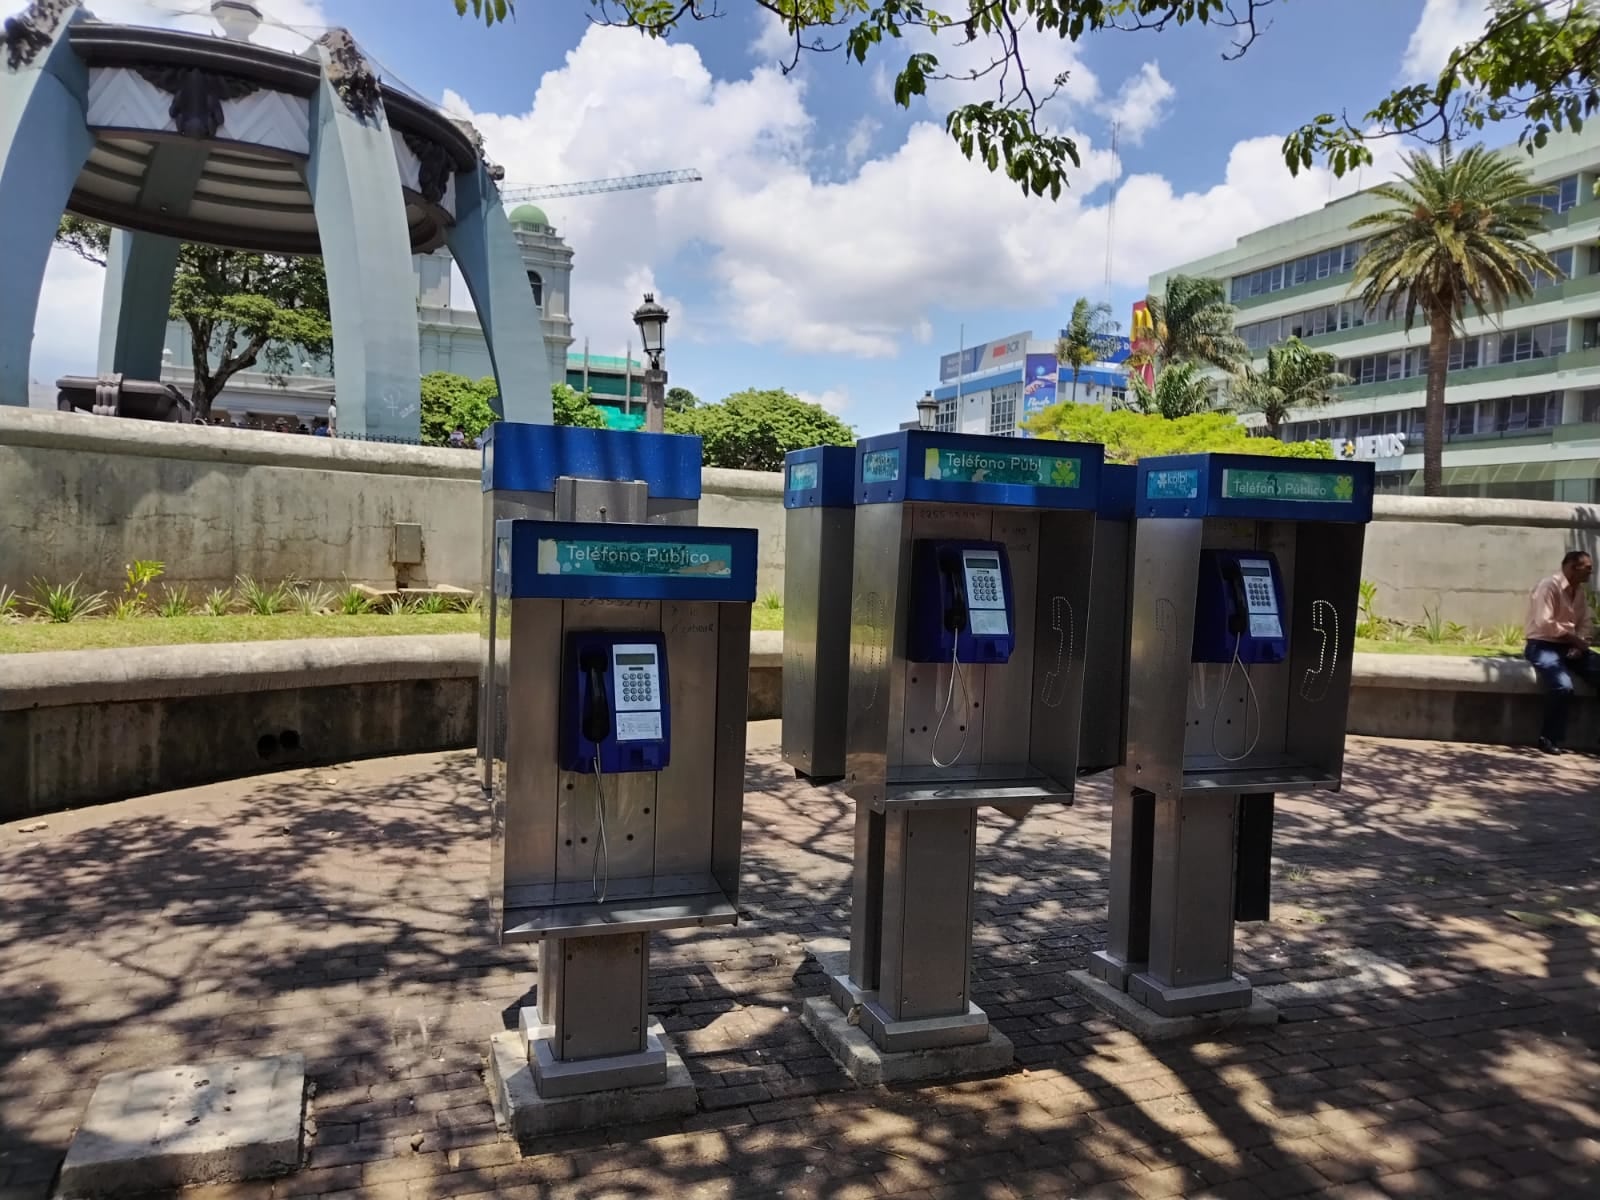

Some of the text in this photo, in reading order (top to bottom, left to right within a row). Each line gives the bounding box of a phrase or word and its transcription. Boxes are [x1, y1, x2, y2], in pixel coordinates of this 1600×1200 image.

[946, 453, 1005, 470] Teléfono
[1285, 482, 1327, 496] Público
[565, 545, 710, 564] Teléfono Público
